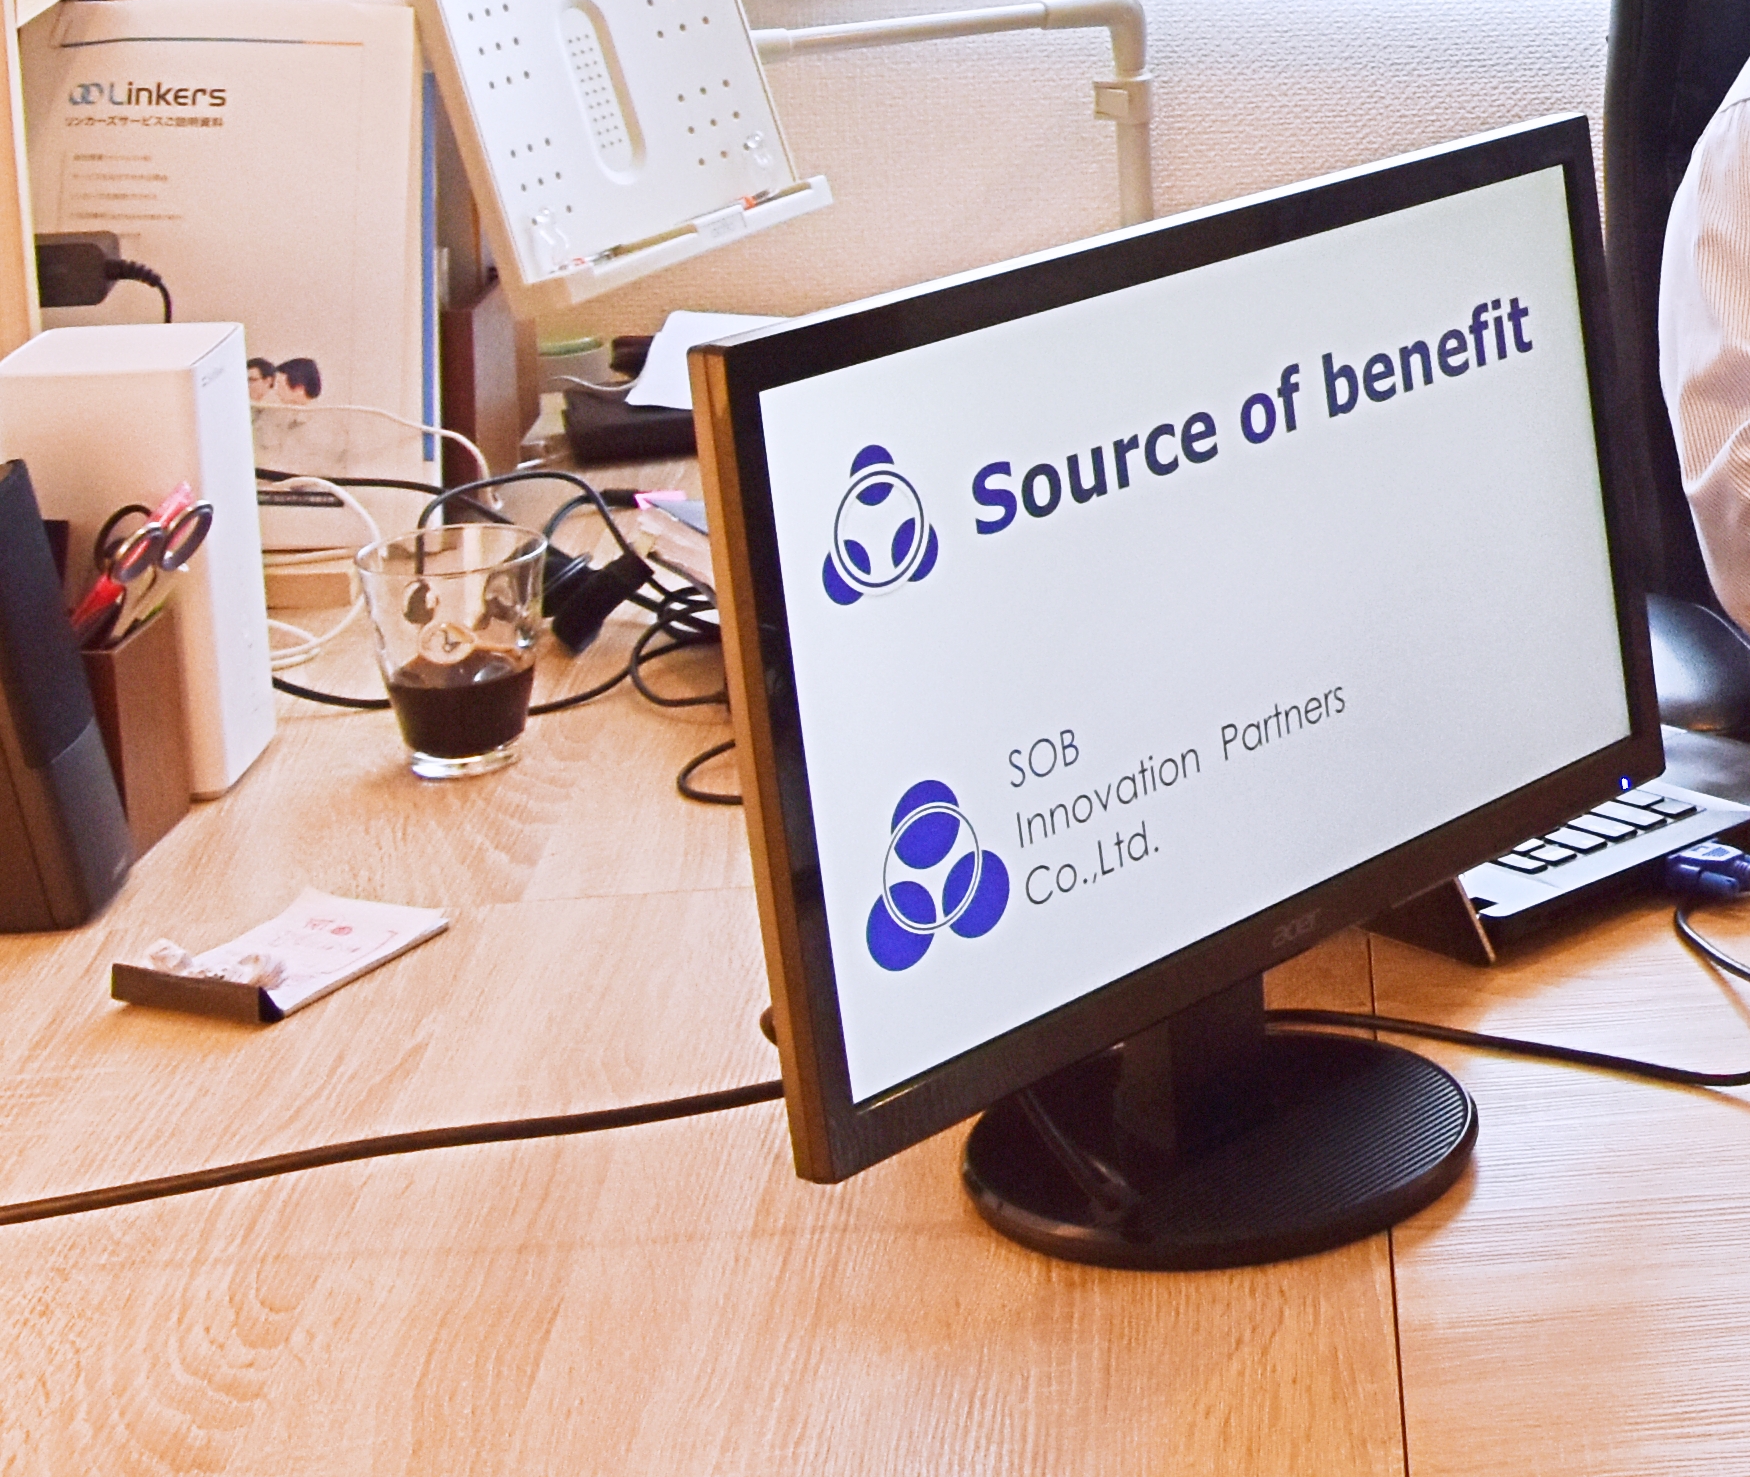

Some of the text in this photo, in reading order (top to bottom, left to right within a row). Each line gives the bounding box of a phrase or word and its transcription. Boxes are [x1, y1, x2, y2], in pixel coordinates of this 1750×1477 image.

[109, 81, 227, 107] Linkers
[971, 296, 1534, 536] Source of benefit
[1008, 729, 1080, 788] SOB
[1016, 684, 1347, 849] Innovation Partners
[1025, 820, 1160, 905] Co.,Ltd.
